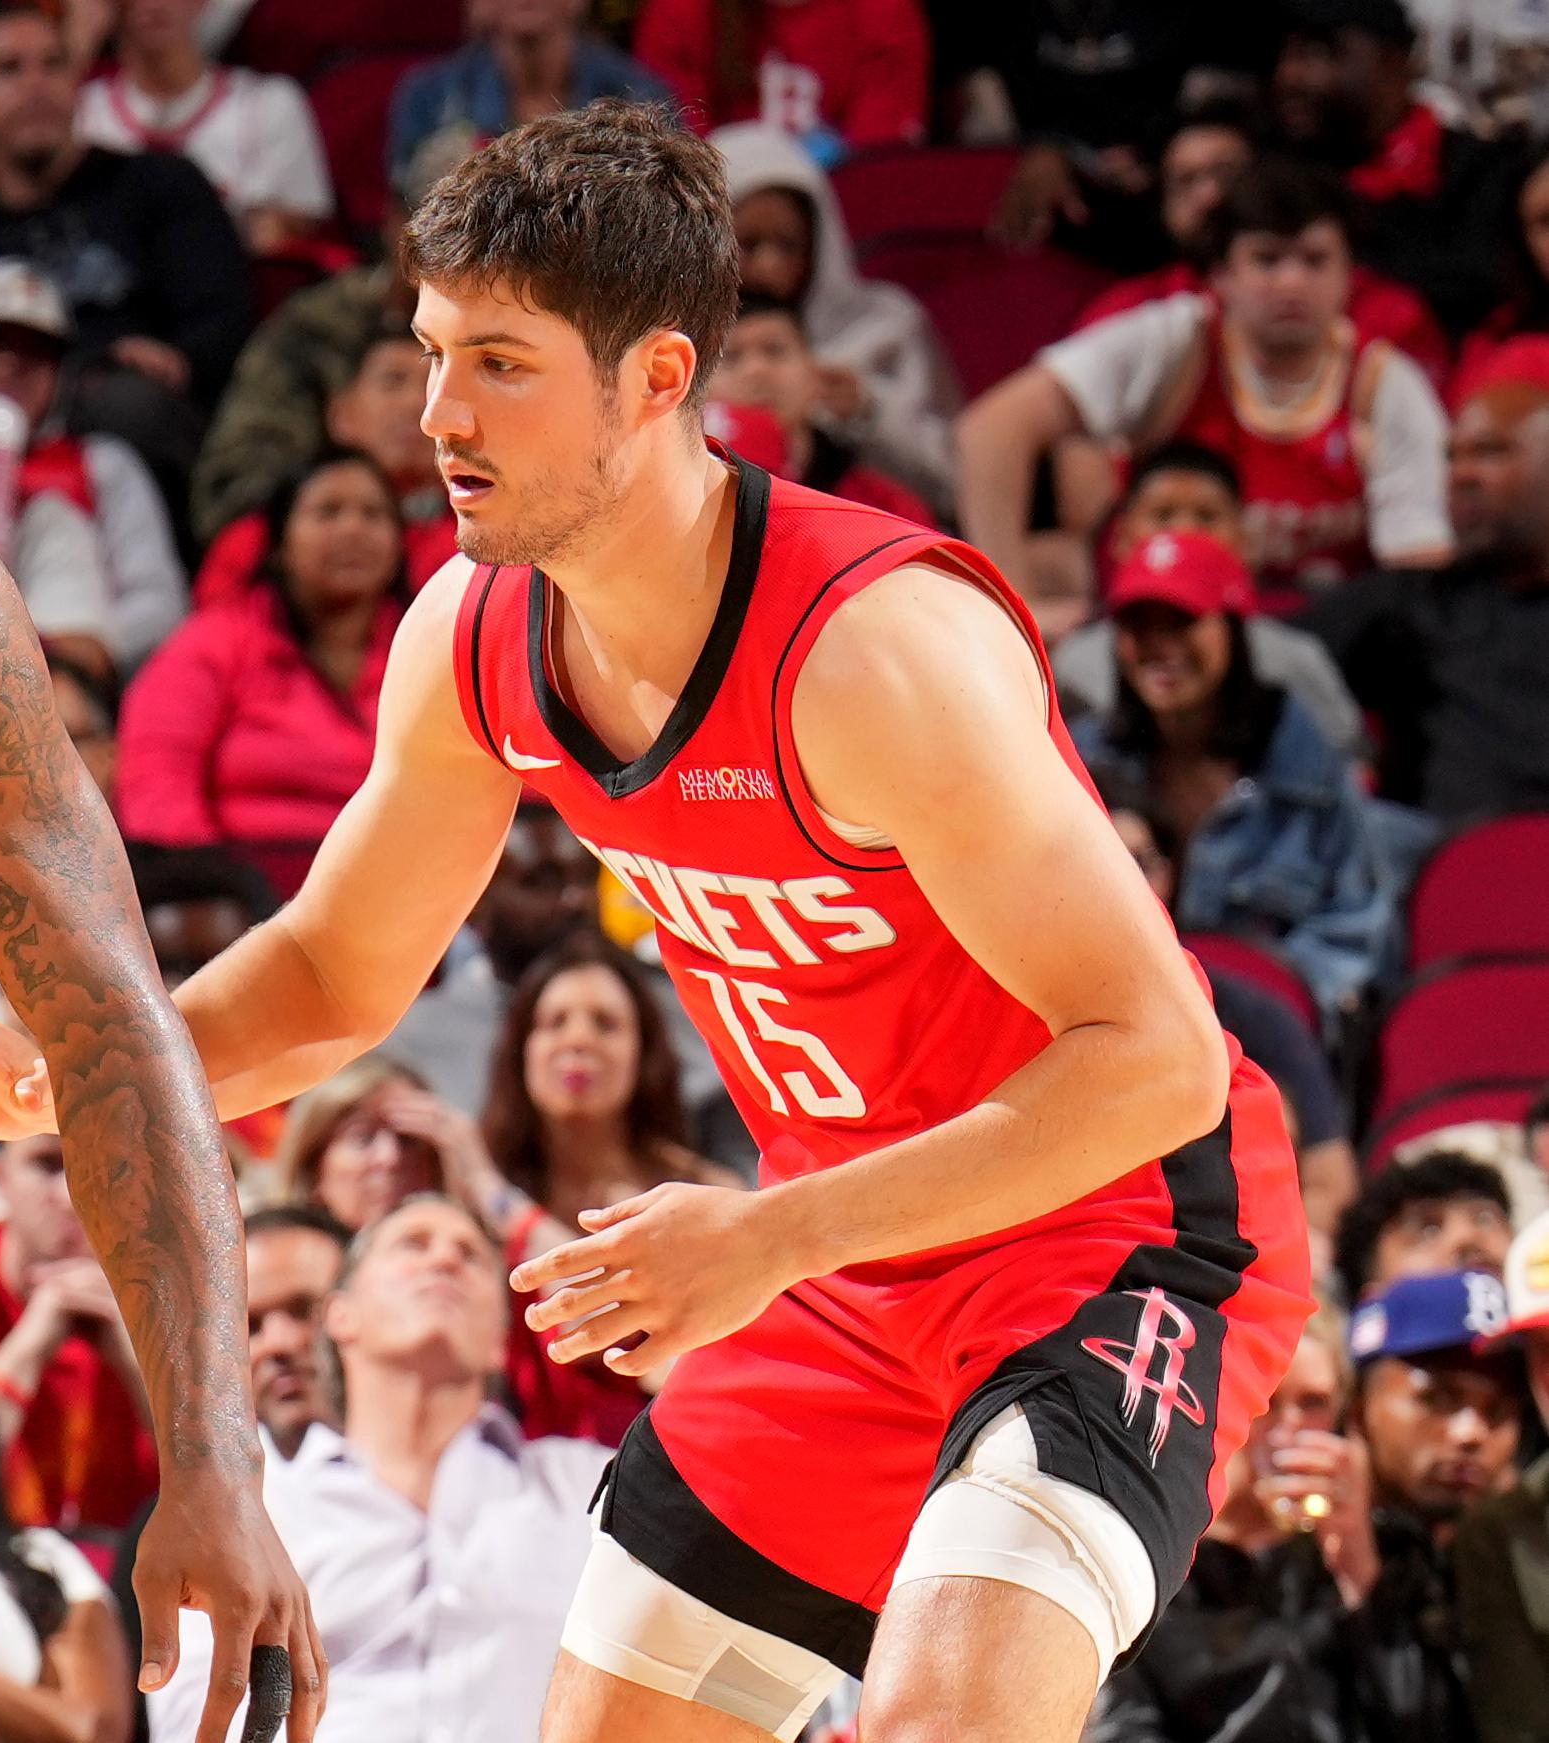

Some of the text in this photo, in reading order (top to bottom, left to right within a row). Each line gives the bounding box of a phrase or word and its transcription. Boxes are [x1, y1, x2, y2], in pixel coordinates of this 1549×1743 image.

[677, 766, 772, 790] MEMORIAL
[679, 782, 776, 801] HERMANN
[576, 834, 898, 970] CKETS
[685, 967, 867, 1119] 15
